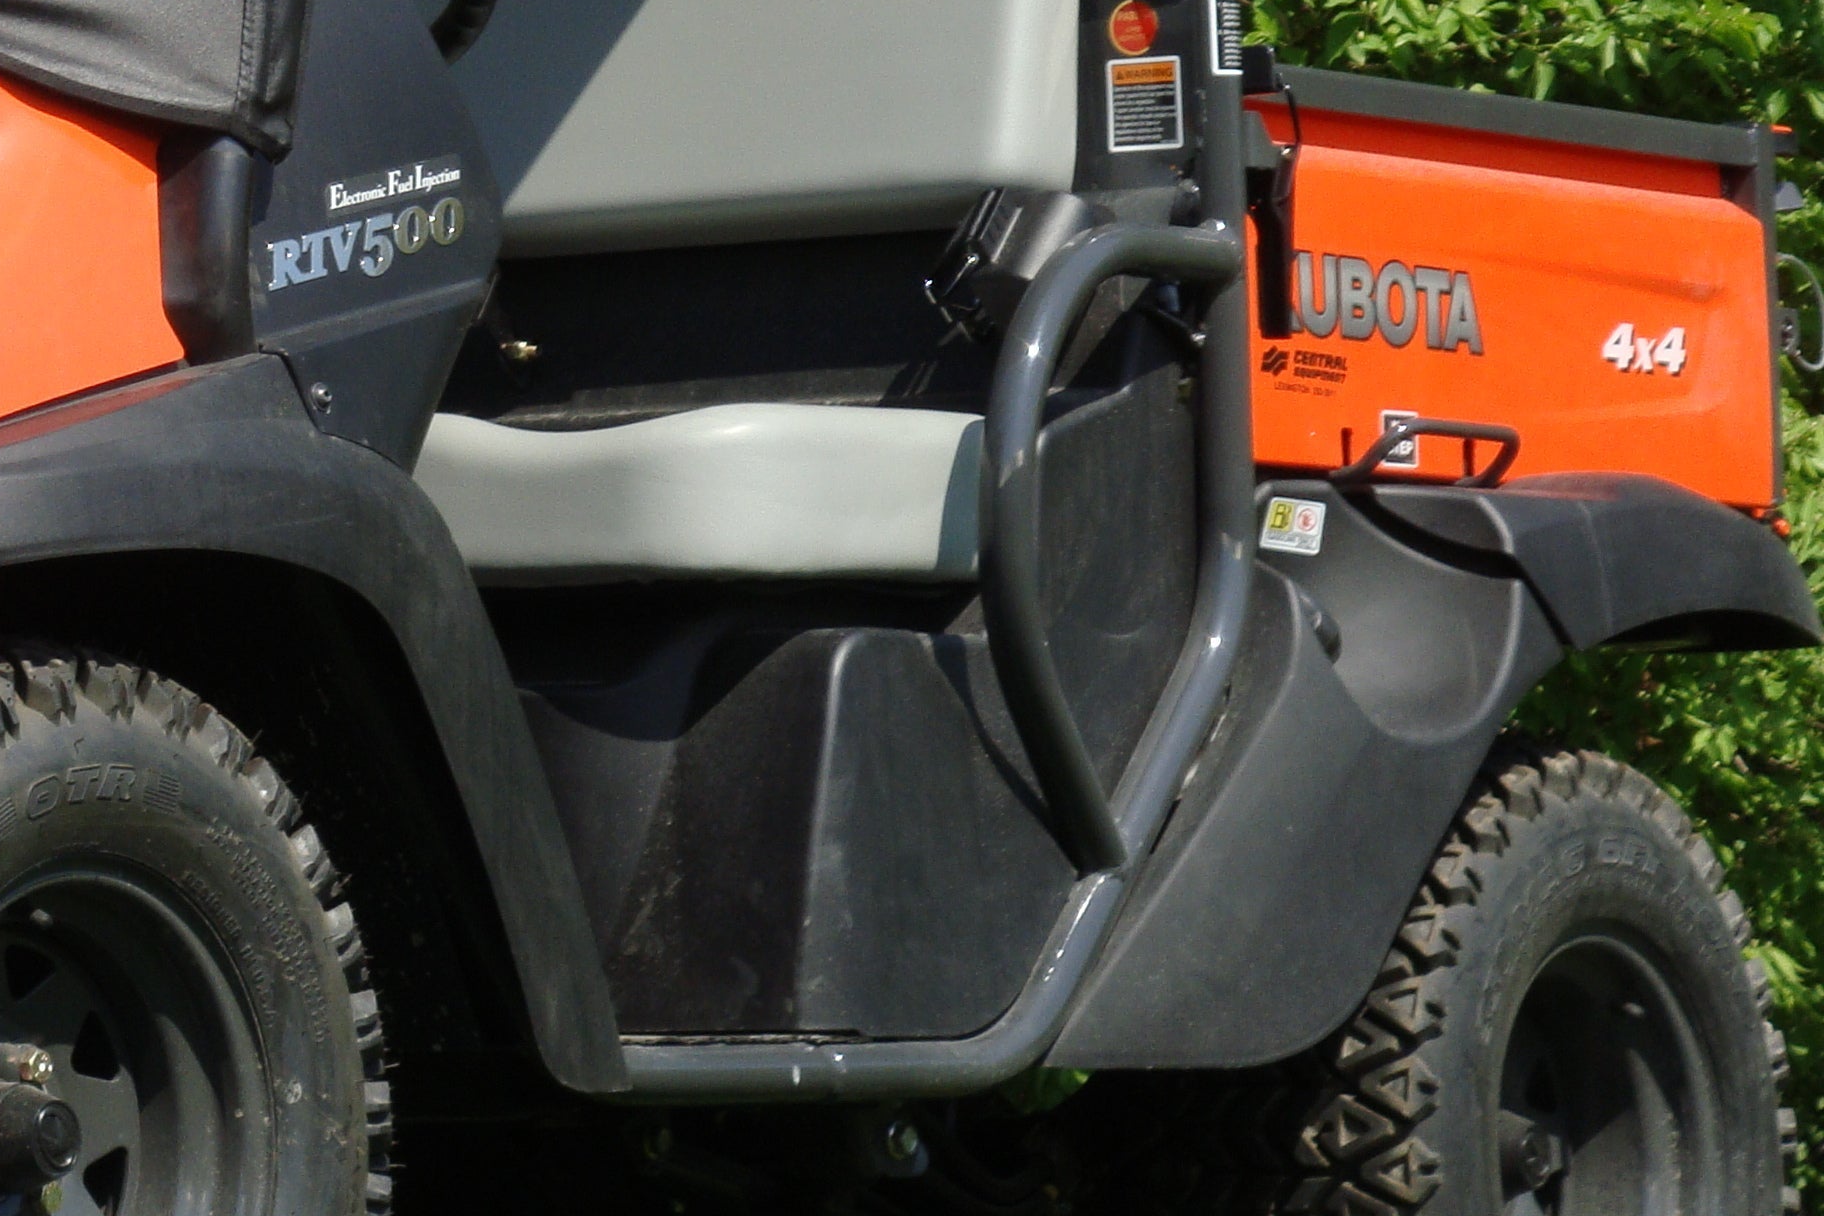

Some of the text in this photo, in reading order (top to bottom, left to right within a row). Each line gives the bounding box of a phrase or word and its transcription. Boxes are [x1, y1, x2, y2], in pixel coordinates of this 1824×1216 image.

[1125, 66, 1173, 81] WARNING
[329, 164, 461, 210] Electronic Fuel Injection
[1291, 249, 1484, 356] UBOTA
[1293, 350, 1348, 371] CENTRAL
[1602, 322, 1687, 376] 4x4
[27, 763, 137, 820] OTR
